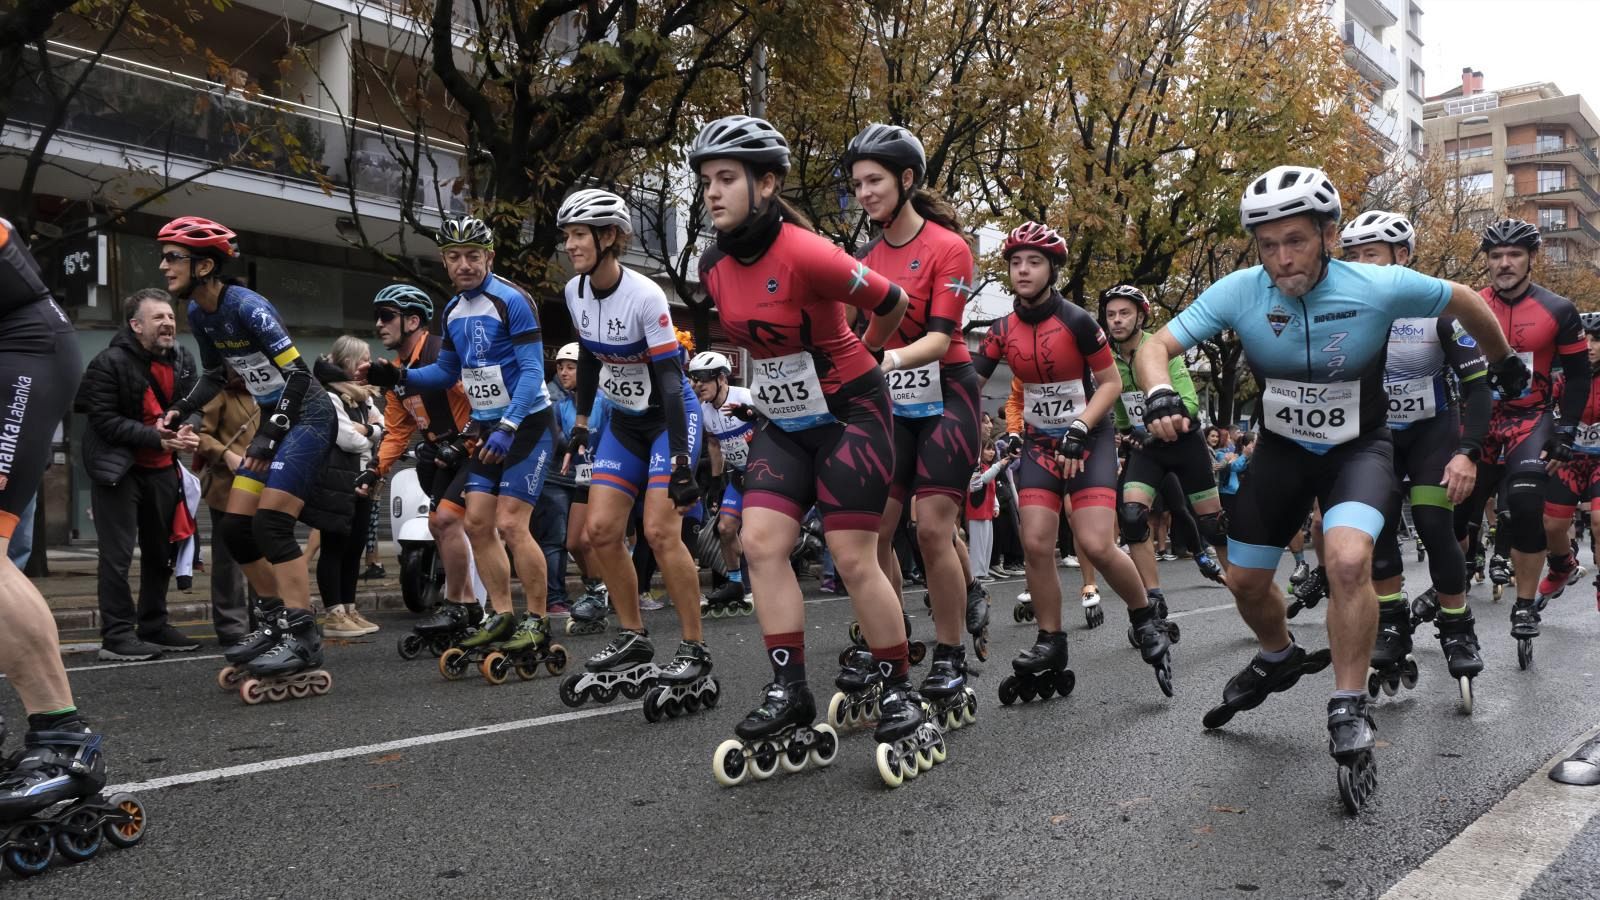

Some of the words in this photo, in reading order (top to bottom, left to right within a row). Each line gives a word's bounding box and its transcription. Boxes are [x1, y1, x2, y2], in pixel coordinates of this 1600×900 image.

[468, 384, 502, 399] 4258
[603, 379, 645, 397] 4263
[757, 381, 809, 404] 4213
[1271, 387, 1297, 398] SALTO
[893, 393, 916, 401] LOREA
[768, 404, 807, 415] GOIZEDER
[1032, 400, 1076, 417] 4174
[1276, 407, 1346, 428] 4108
[1292, 428, 1328, 440] IMANOL
